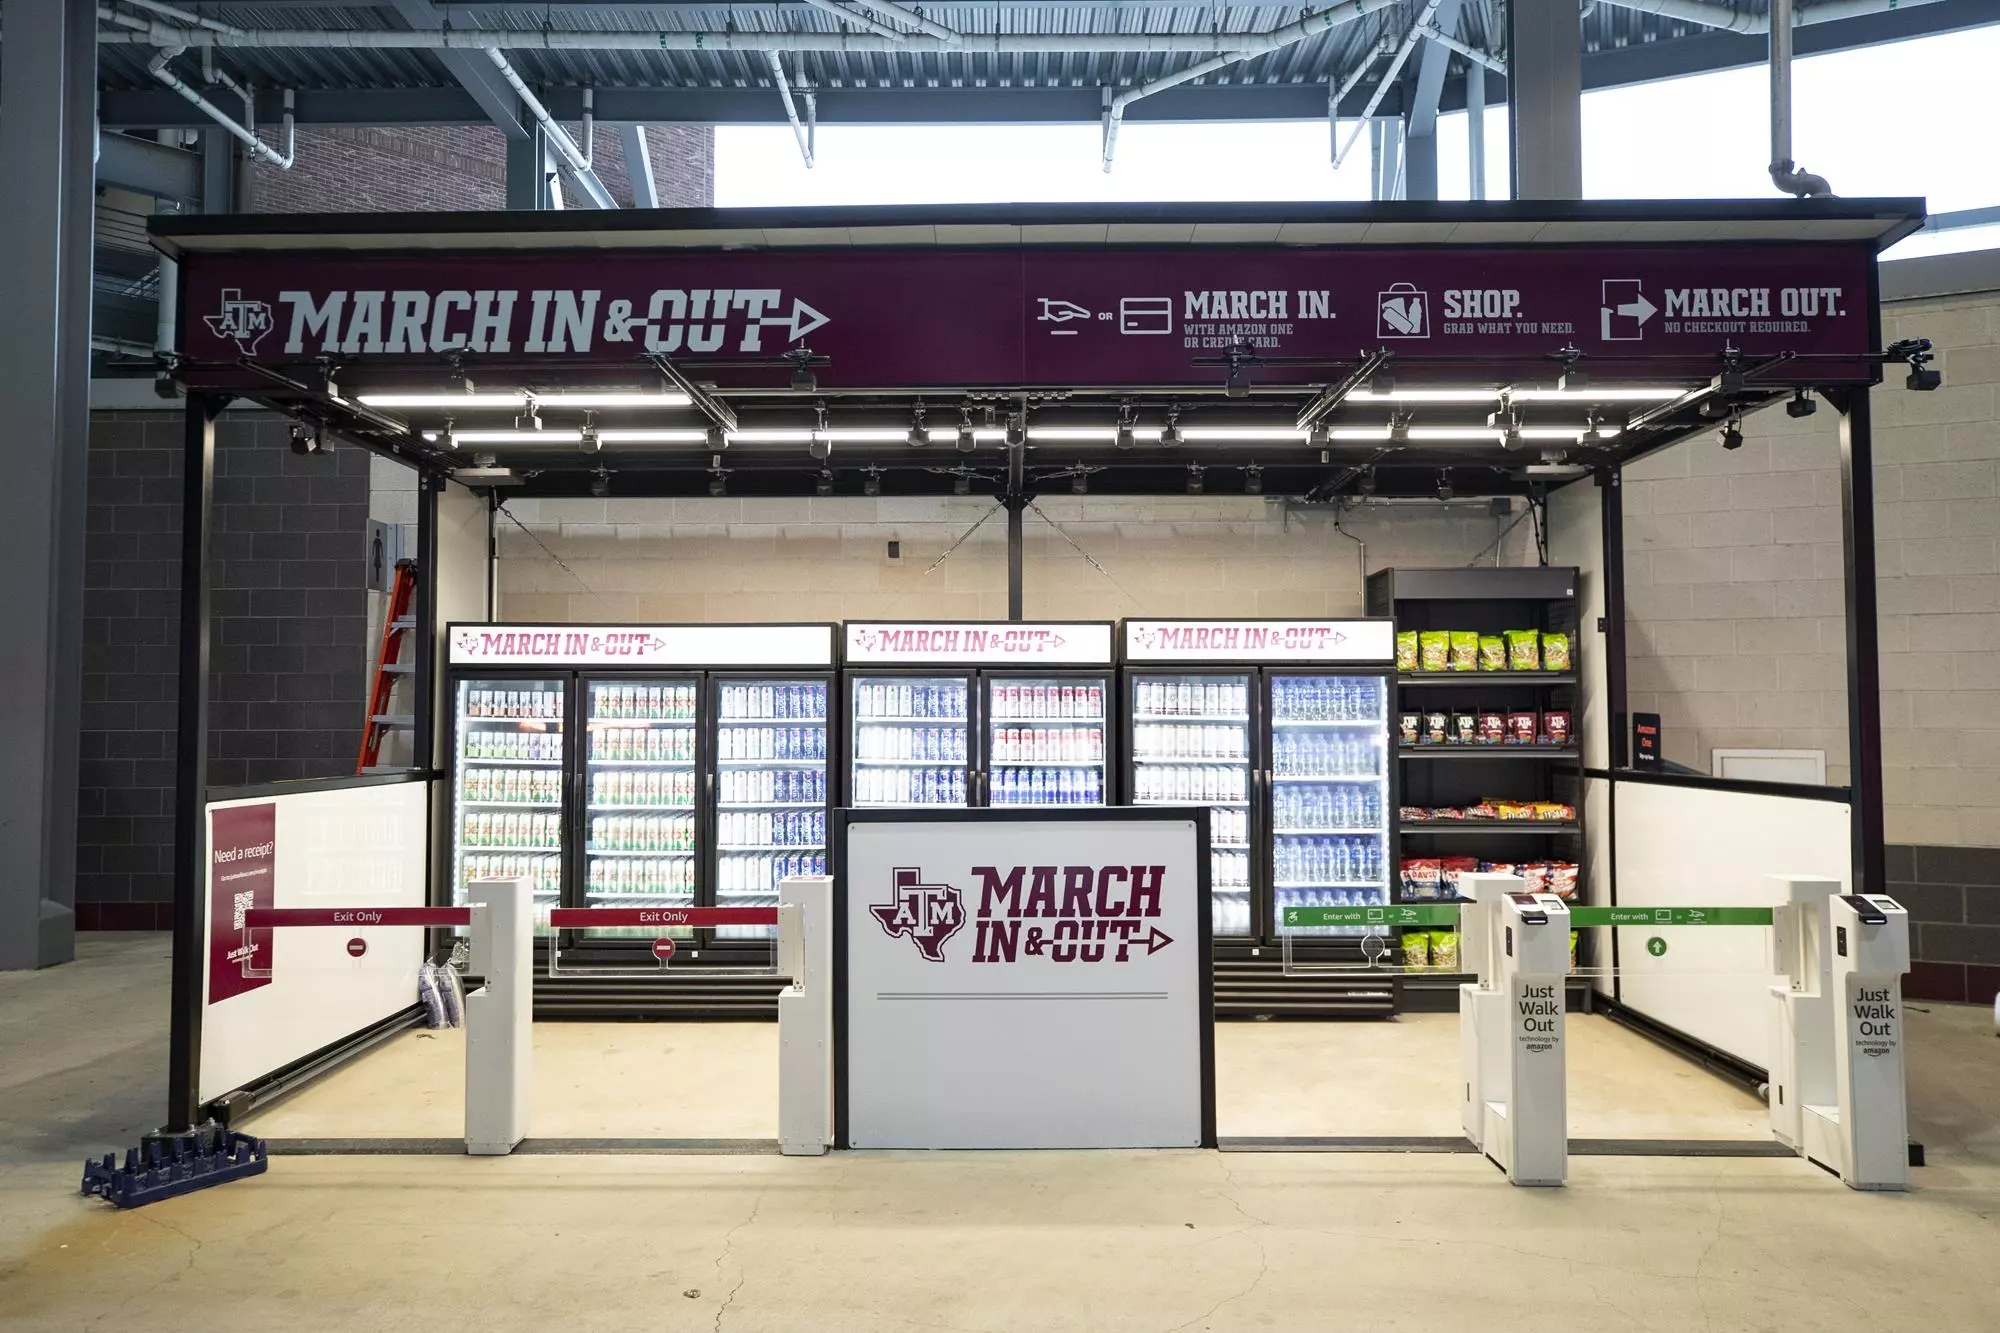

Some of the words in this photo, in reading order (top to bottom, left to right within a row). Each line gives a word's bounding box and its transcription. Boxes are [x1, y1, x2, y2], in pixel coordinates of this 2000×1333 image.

[1184, 291, 1287, 319] MARCH
[1298, 290, 1336, 319] IN.
[1443, 290, 1523, 318] SHOP.
[1664, 288, 1771, 317] MARCH
[1780, 287, 1846, 317] OUT.
[279, 290, 518, 353] MARCH
[524, 290, 601, 352] IN
[1098, 312, 1113, 320] OR
[1184, 324, 1215, 335] WITH
[1218, 324, 1265, 335] AMAZON
[1270, 323, 1293, 335] ONE
[1443, 322, 1474, 334] GRAB
[1477, 322, 1512, 334] WHAT
[1515, 322, 1538, 334] YOU
[1541, 322, 1575, 334] NEED.
[1664, 321, 1681, 333] NO
[1684, 321, 1746, 333] CHECKOUT
[1750, 321, 1811, 333] REQUIRED.
[1184, 336, 1199, 348] OR
[480, 633, 561, 656] MARCH
[564, 633, 589, 656] IN
[878, 630, 960, 652] MARCH
[962, 630, 988, 652] IN
[1157, 628, 1239, 649] MARCH
[1243, 628, 1268, 649] IN
[214, 847, 236, 863] Need
[237, 849, 243, 859] a
[244, 841, 273, 858] receipt?
[971, 866, 1166, 917] MARCH
[334, 912, 354, 922] Exit
[356, 911, 382, 924] Only
[640, 912, 660, 922] Exit
[662, 911, 688, 923] Only
[1344, 912, 1361, 920] with
[972, 920, 1022, 962] IN
[226, 950, 237, 960] Just
[1521, 984, 1555, 998] Just
[1856, 987, 1890, 1002] Just
[1519, 1001, 1559, 1016] Walk
[1854, 1004, 1896, 1019] Walk
[1524, 1017, 1555, 1032] Out
[1860, 1021, 1892, 1036] Out
